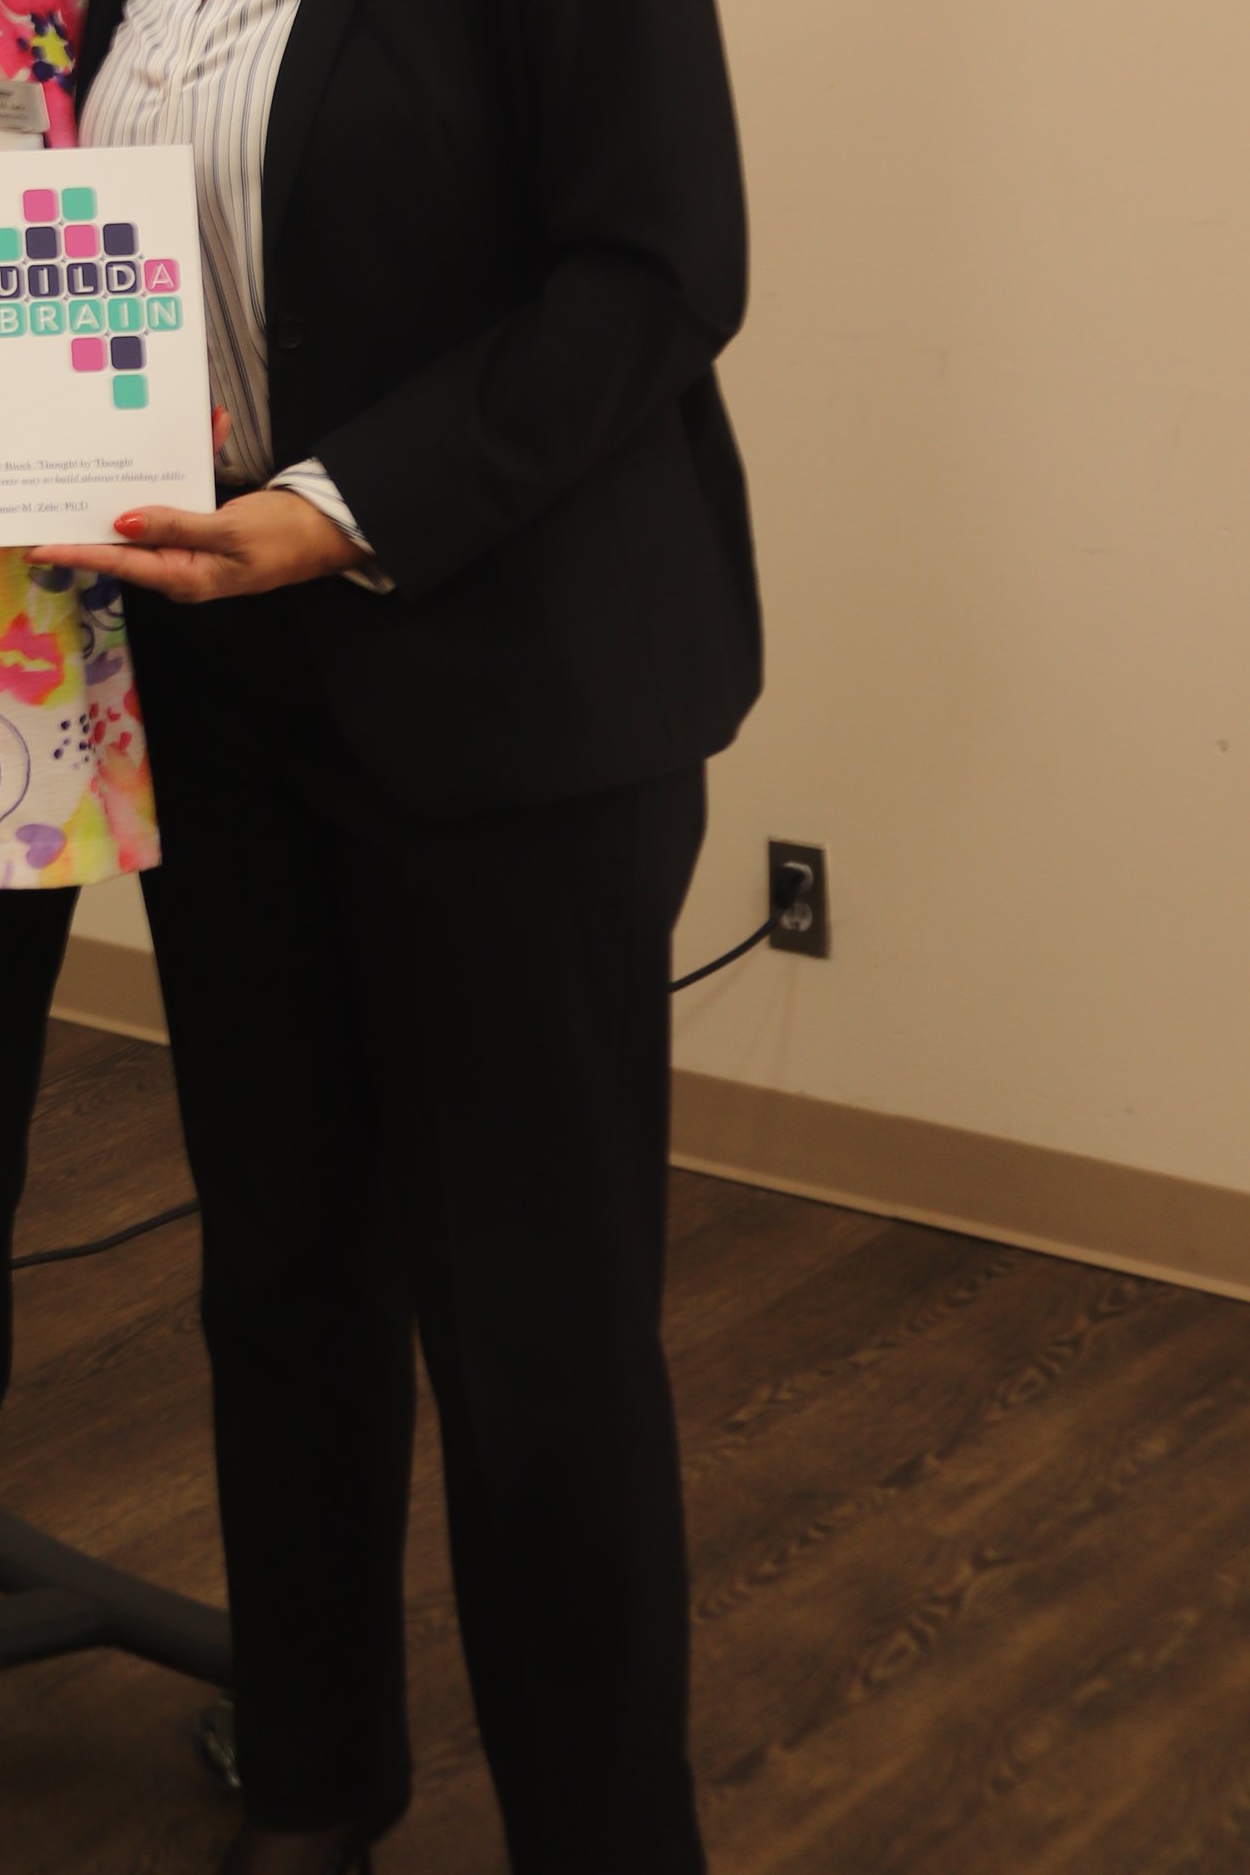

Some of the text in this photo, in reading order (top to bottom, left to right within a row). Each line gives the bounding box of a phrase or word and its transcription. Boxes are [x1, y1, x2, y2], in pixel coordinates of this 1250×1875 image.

[148, 262, 177, 291] A
[37, 458, 78, 471] Thought
[94, 456, 134, 469] Thought
